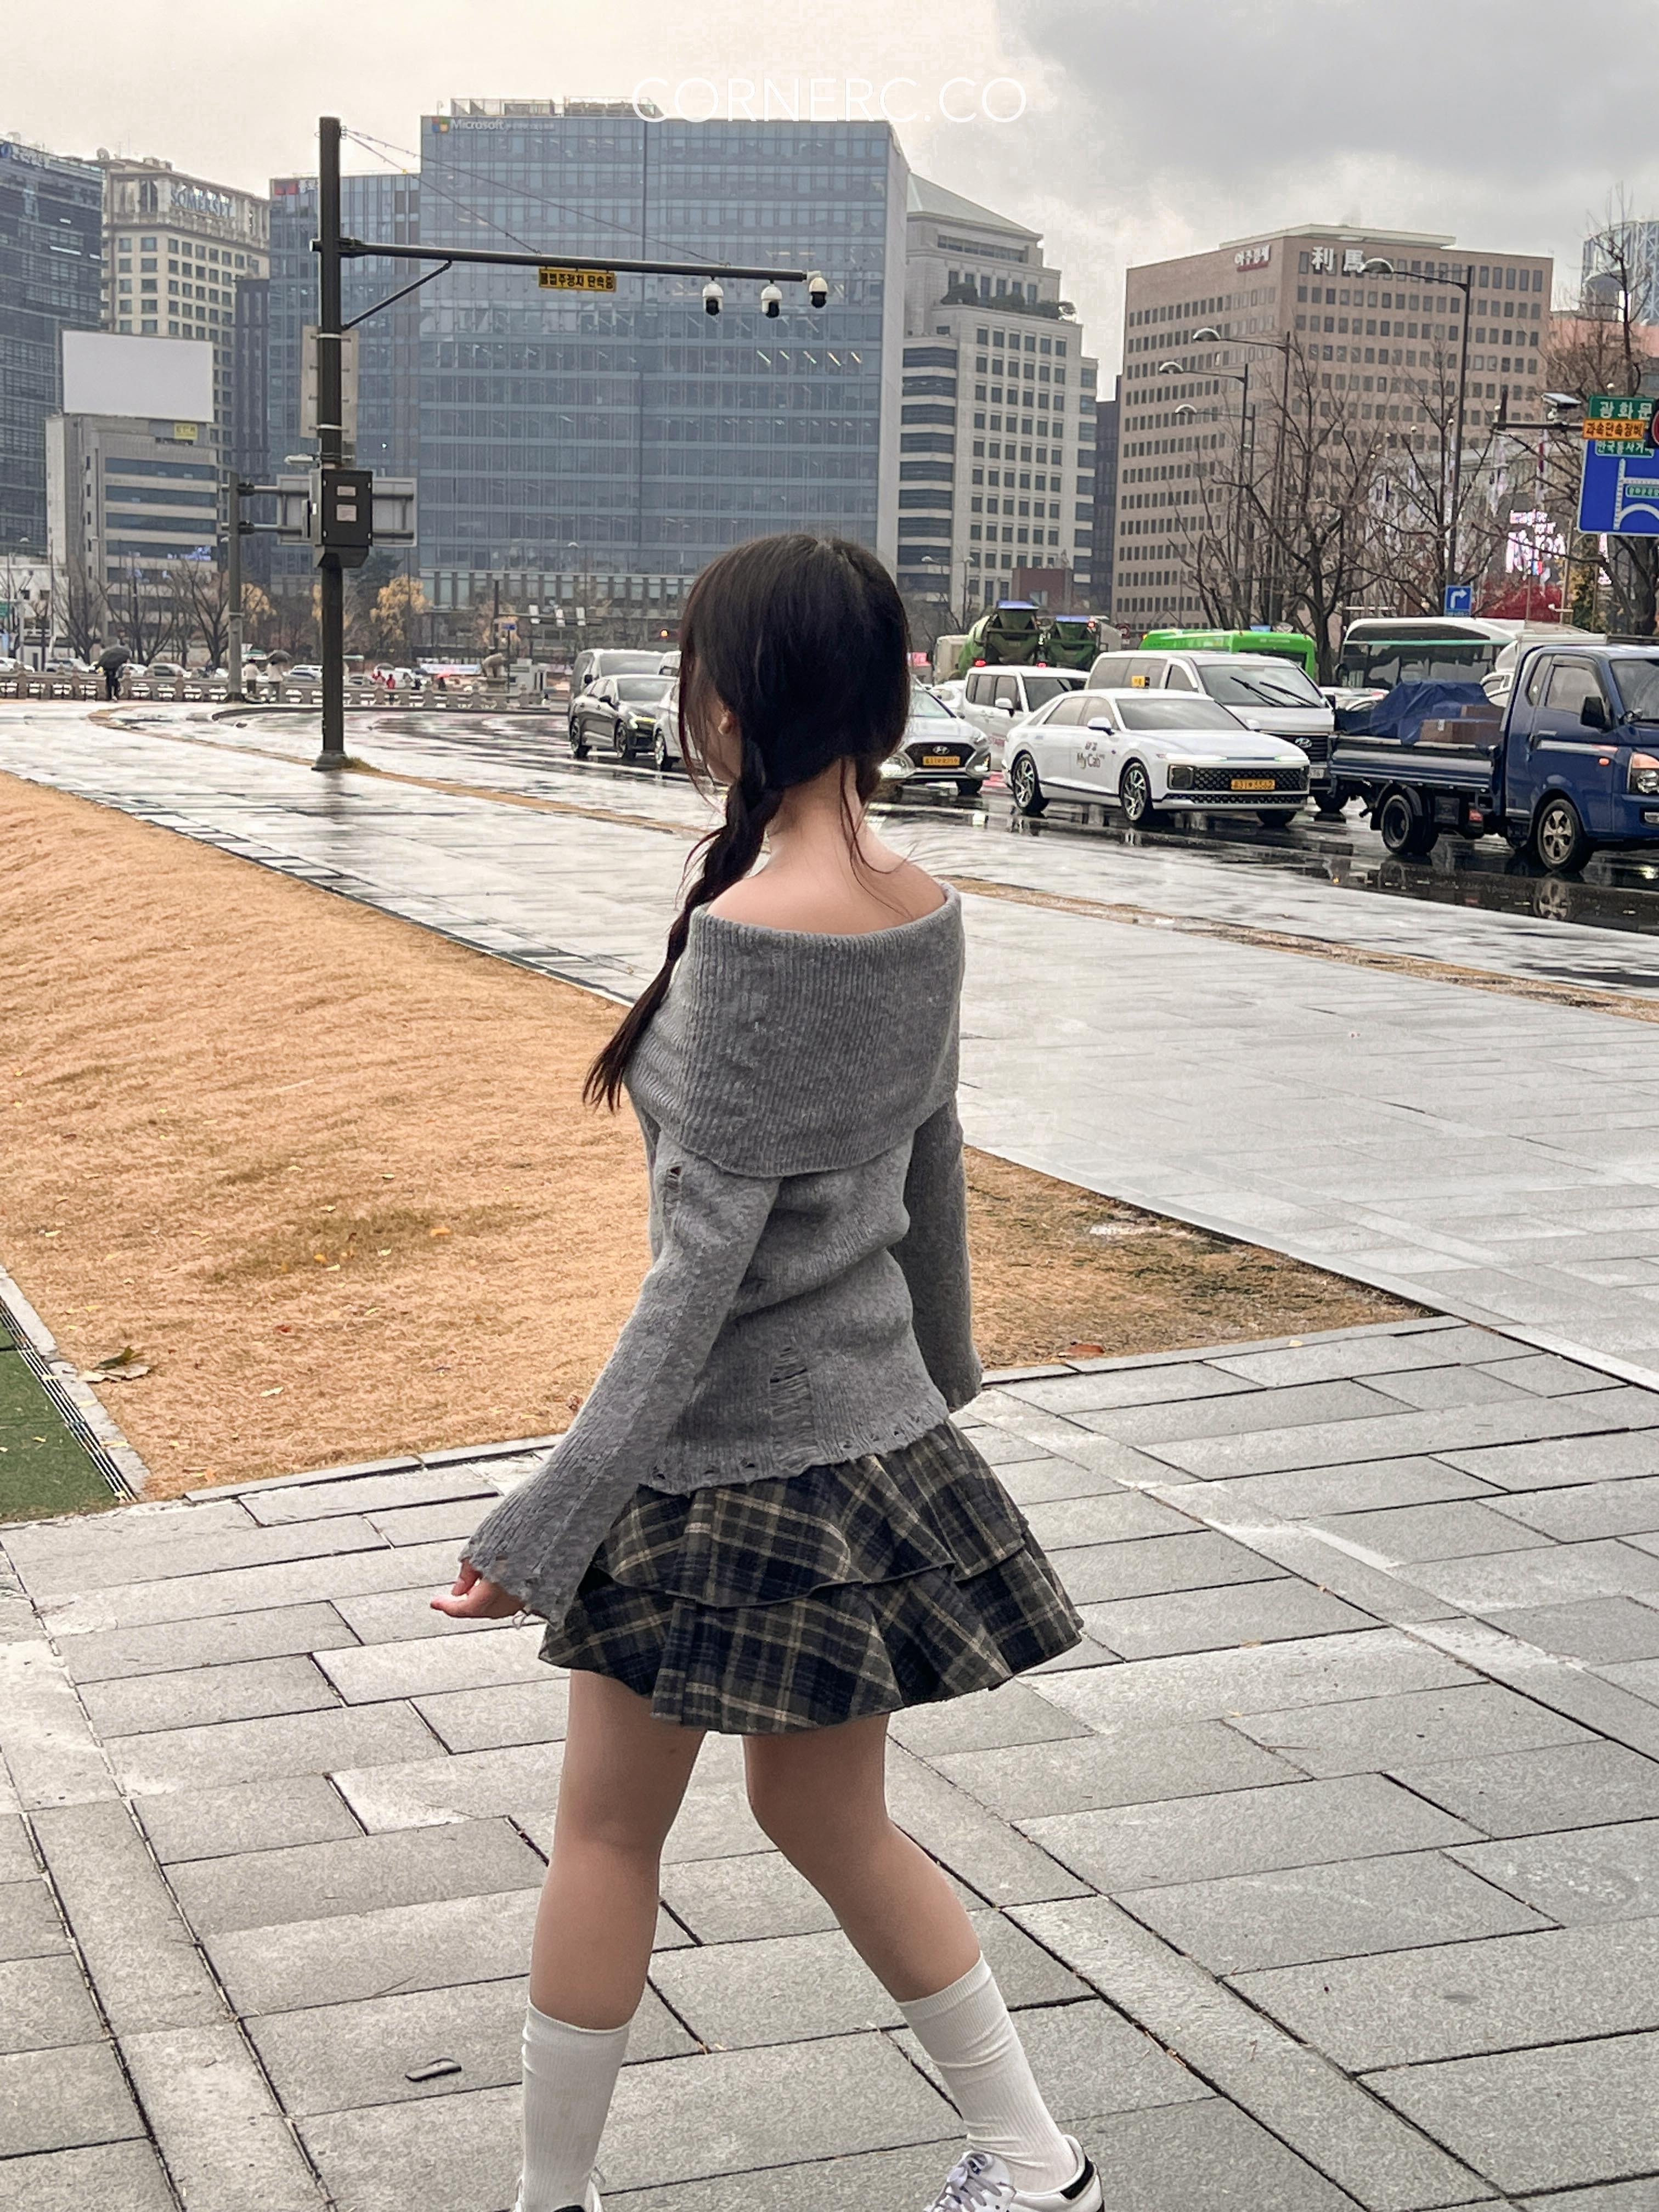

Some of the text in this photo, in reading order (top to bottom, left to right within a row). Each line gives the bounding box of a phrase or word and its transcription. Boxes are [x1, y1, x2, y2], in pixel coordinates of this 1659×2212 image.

[450, 119, 505, 131] Microsoft
[171, 184, 232, 219] SOMERSET
[1586, 422, 1643, 437] 과속단속장비
